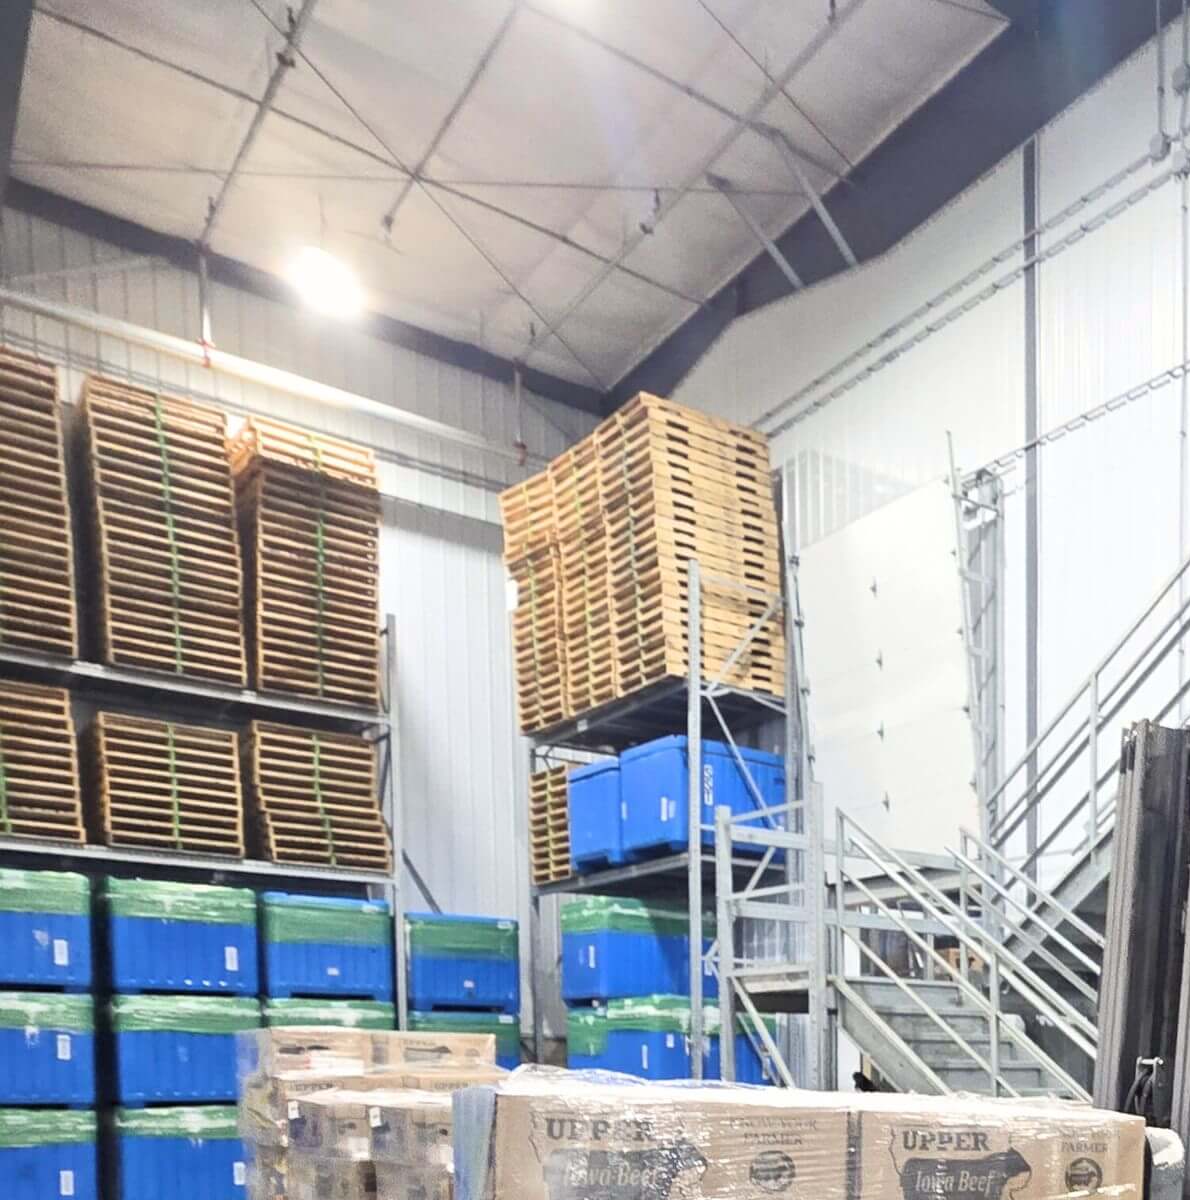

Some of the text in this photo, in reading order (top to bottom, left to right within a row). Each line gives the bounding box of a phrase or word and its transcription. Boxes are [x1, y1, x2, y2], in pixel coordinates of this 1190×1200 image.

[902, 1129, 990, 1151] UPPER
[915, 1169, 996, 1195] Iowa Beef
